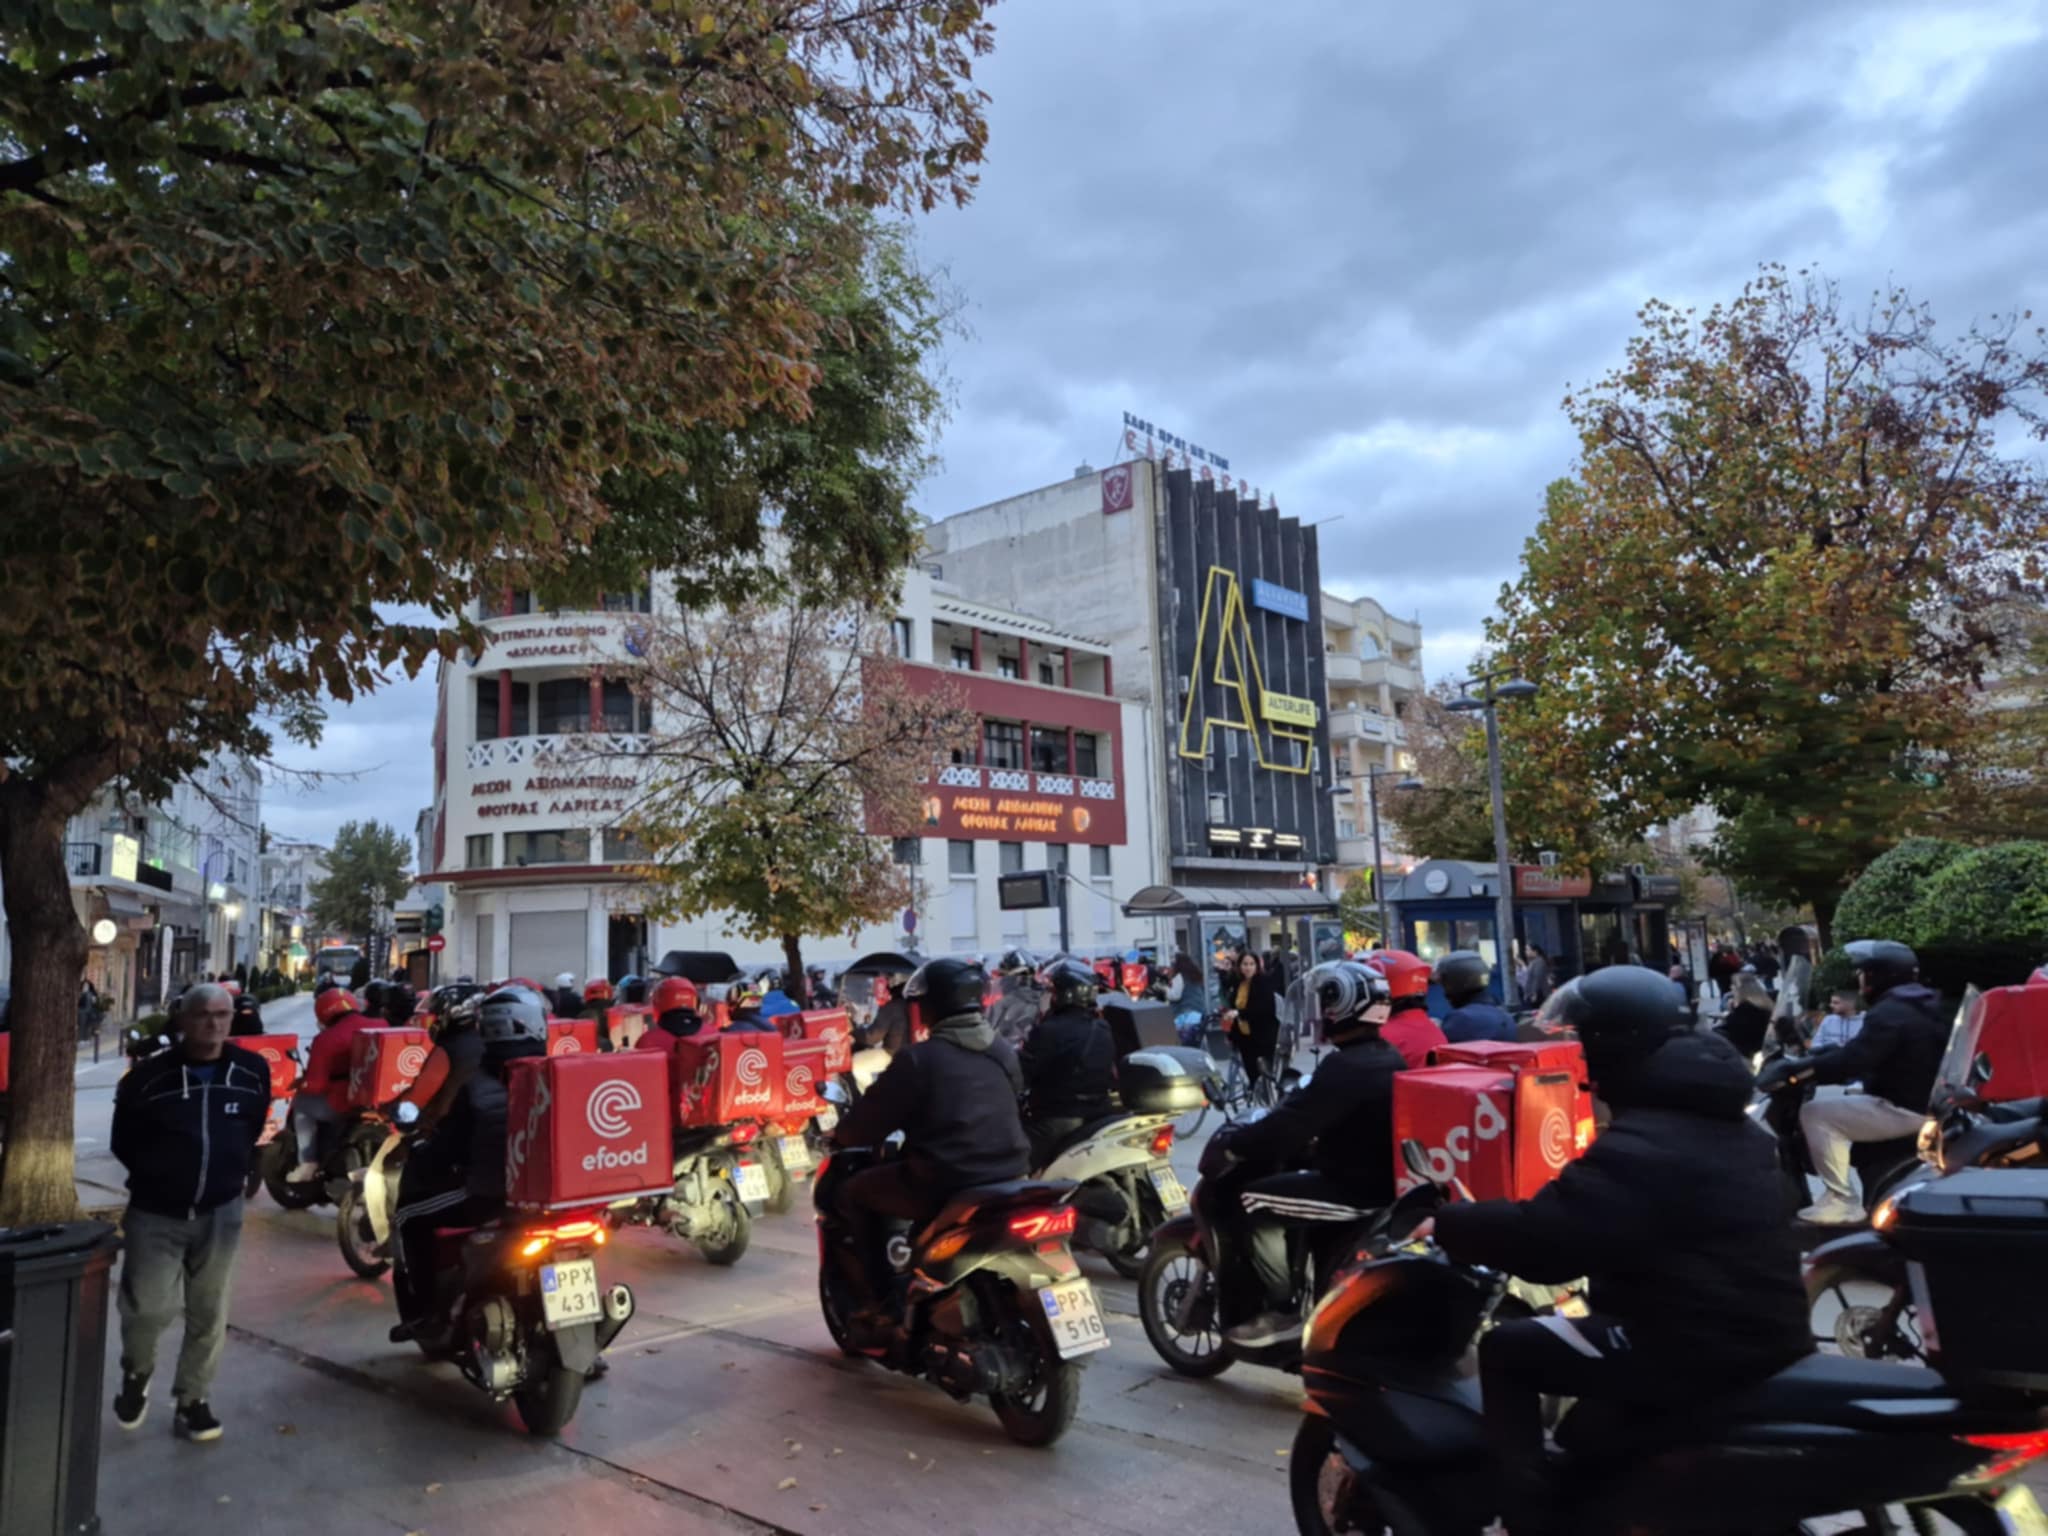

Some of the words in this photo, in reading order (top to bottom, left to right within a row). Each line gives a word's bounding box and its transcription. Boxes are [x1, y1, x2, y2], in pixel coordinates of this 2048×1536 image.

[734, 1086, 771, 1105] efood
[784, 1097, 816, 1113] efood
[582, 1141, 648, 1171] efood
[557, 1266, 593, 1288] PPX
[562, 1291, 596, 1313] 431
[1058, 1288, 1092, 1312] PPX
[1066, 1314, 1101, 1341] 516
